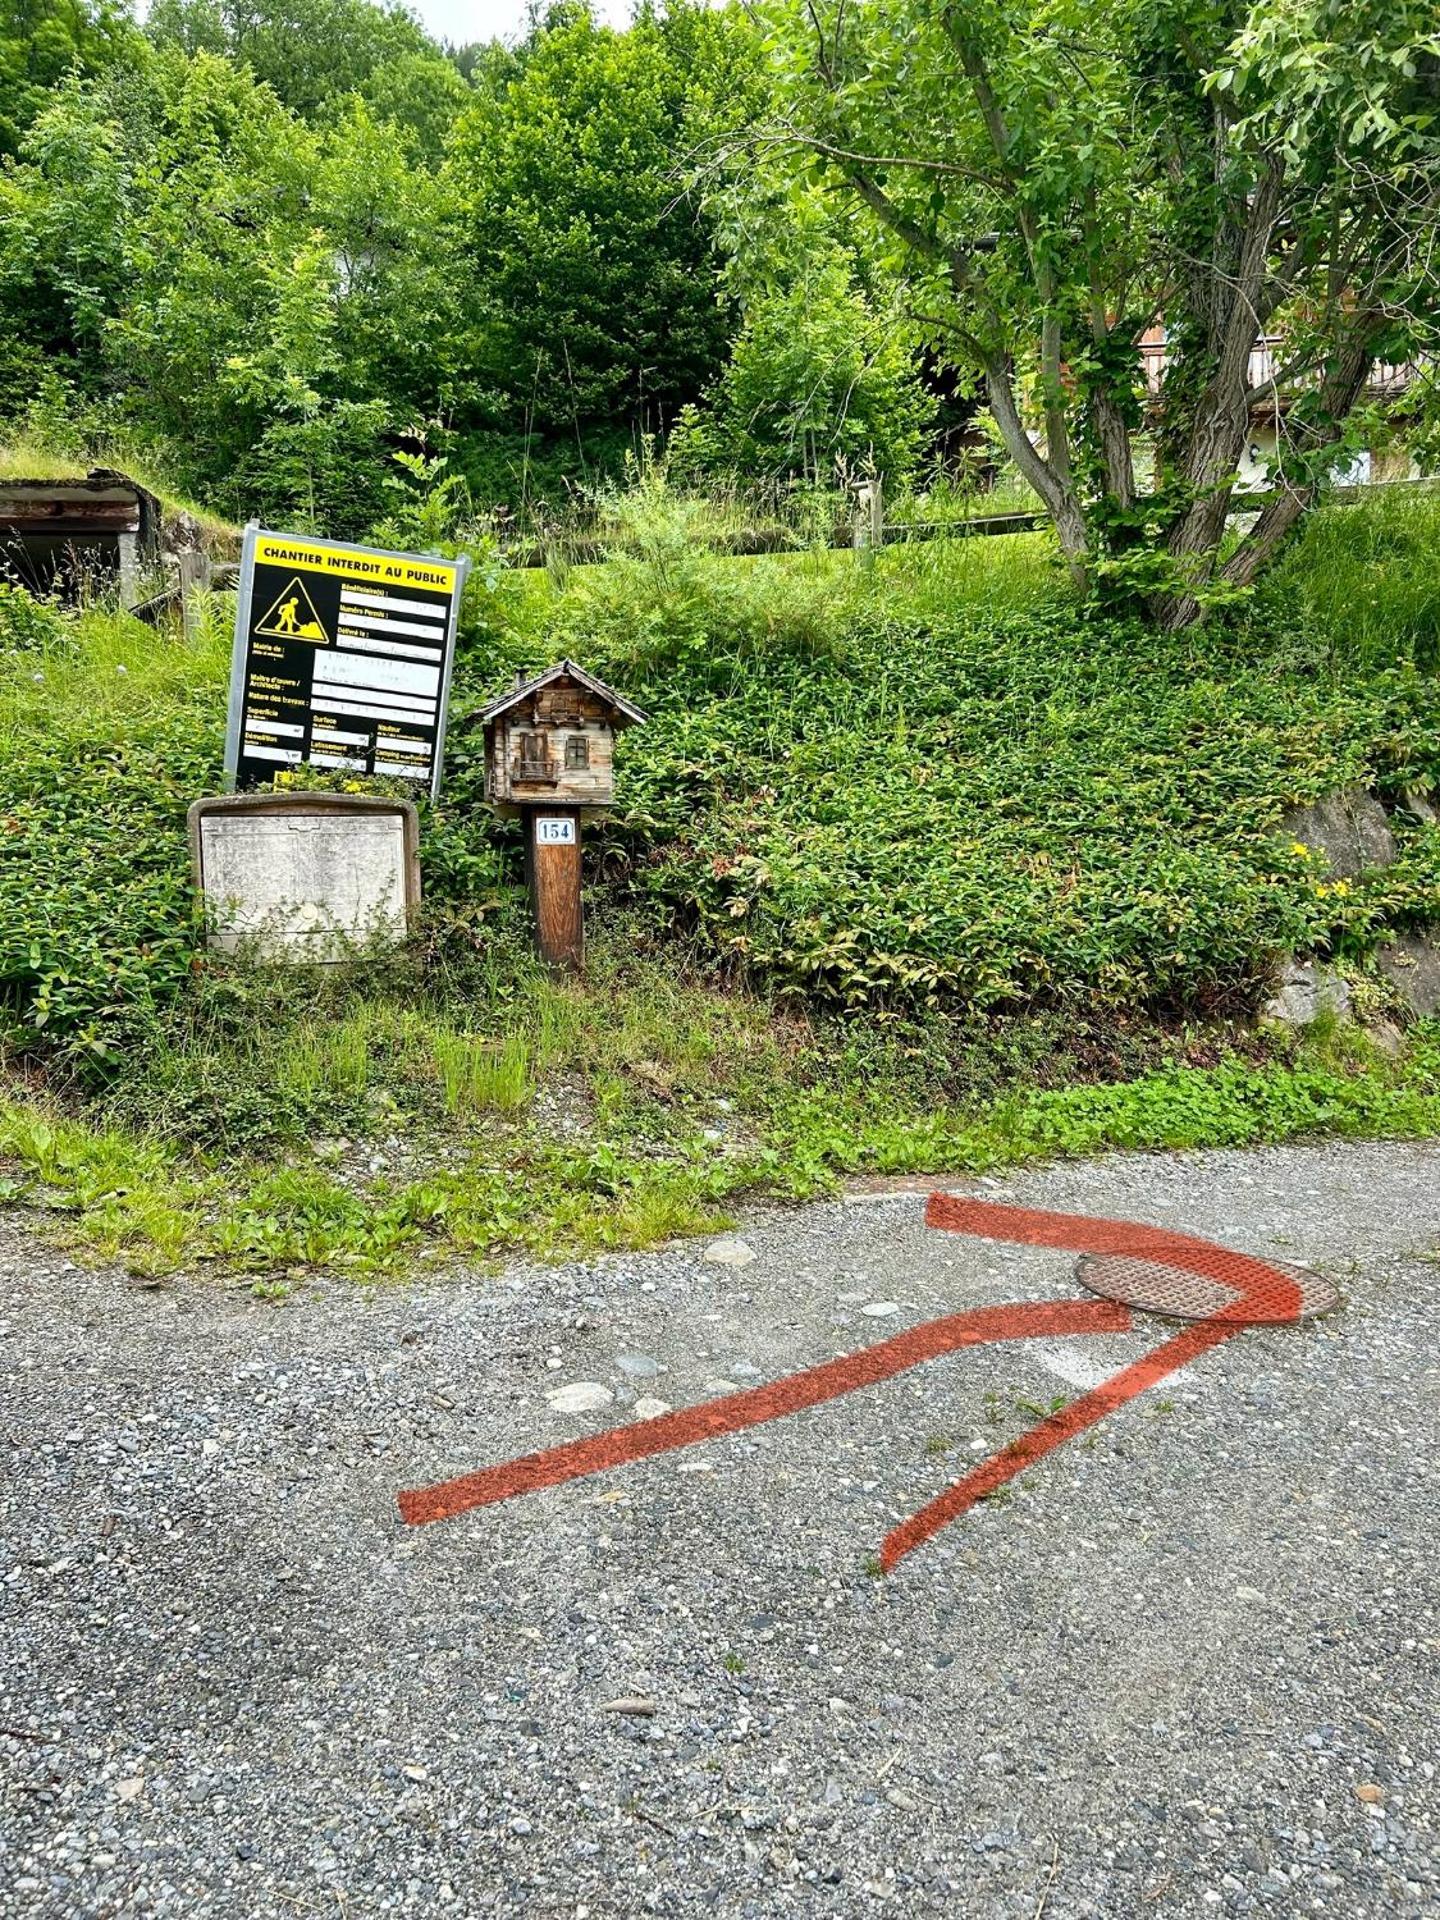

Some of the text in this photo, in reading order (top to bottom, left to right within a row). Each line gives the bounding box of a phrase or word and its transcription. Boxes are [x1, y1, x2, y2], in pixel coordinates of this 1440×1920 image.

[264, 547, 447, 585] CHANTIER INTERDIT AU PUBLIC
[543, 823, 569, 839] 154
